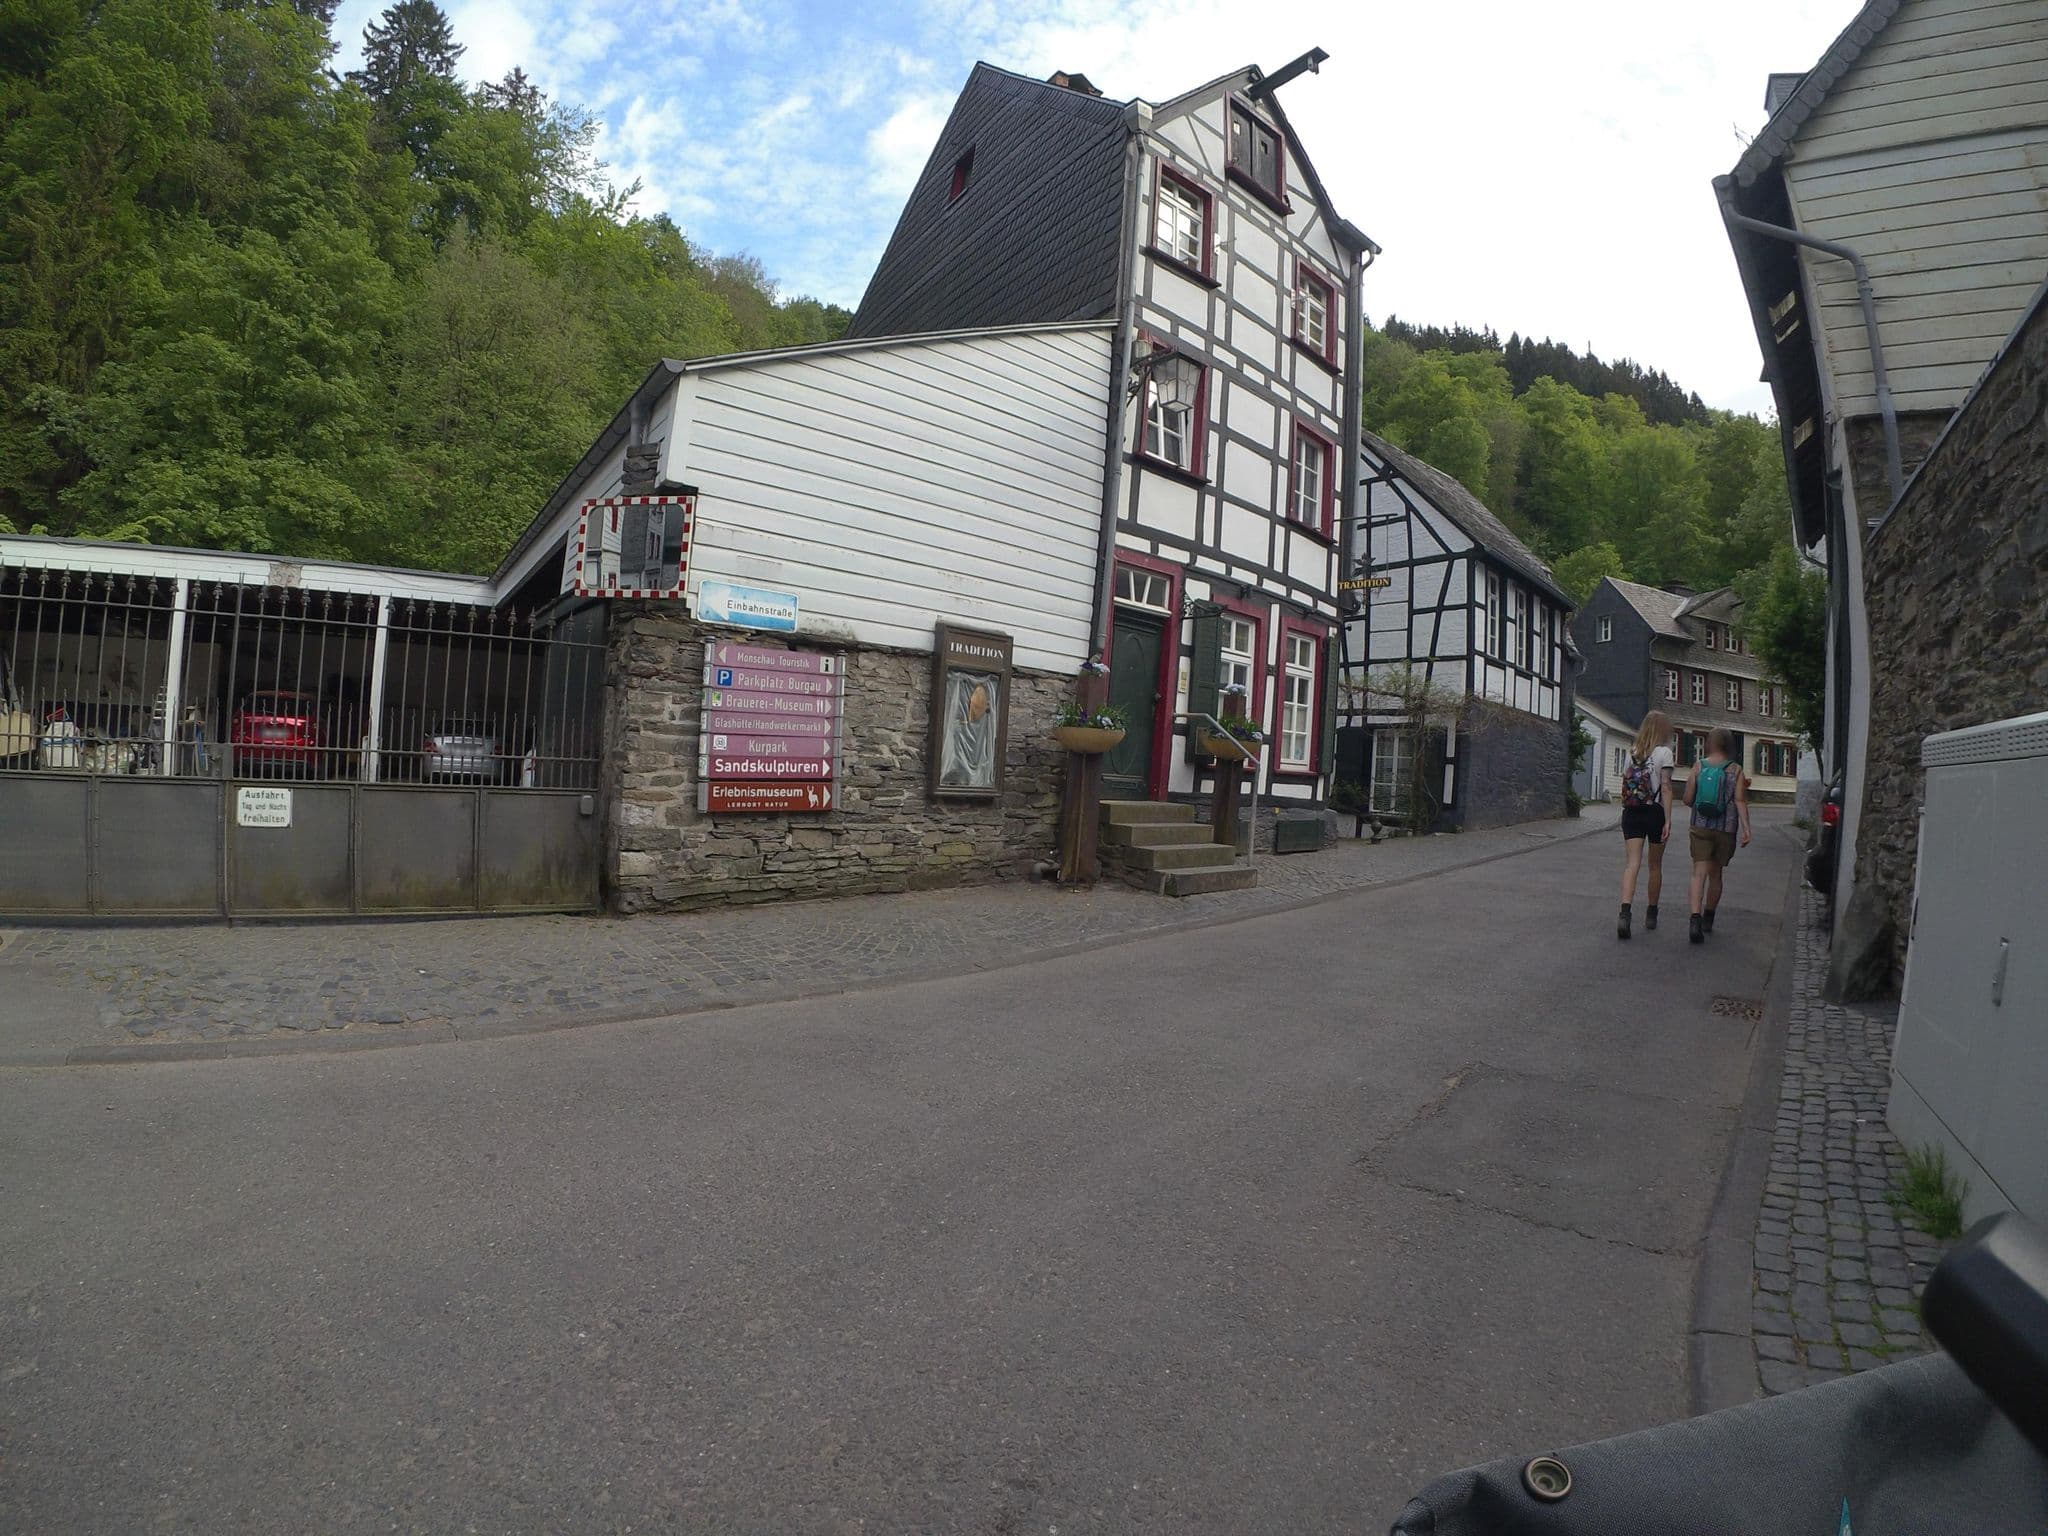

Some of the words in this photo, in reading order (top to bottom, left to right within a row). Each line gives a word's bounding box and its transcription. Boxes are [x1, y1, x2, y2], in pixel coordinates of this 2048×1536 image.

[1338, 578, 1389, 590] TRADITION
[727, 600, 793, 618] Einbahnstraße
[950, 642, 1004, 659] TRADITION
[737, 652, 775, 666] Monschau
[779, 655, 810, 669] Touristik
[738, 673, 784, 690] Parkplatz
[788, 677, 821, 693] Burgau
[726, 694, 813, 712] Brauerei-Museum
[714, 717, 821, 732] Glashütte/Handwerkermarkt
[748, 739, 788, 755] Kurpark
[714, 758, 819, 776] Sandskulpturen
[245, 790, 284, 799] Ausfahrt
[712, 785, 803, 798] Erlebnismuseum
[242, 802, 252, 811] Tag
[243, 814, 285, 823] freihalten
